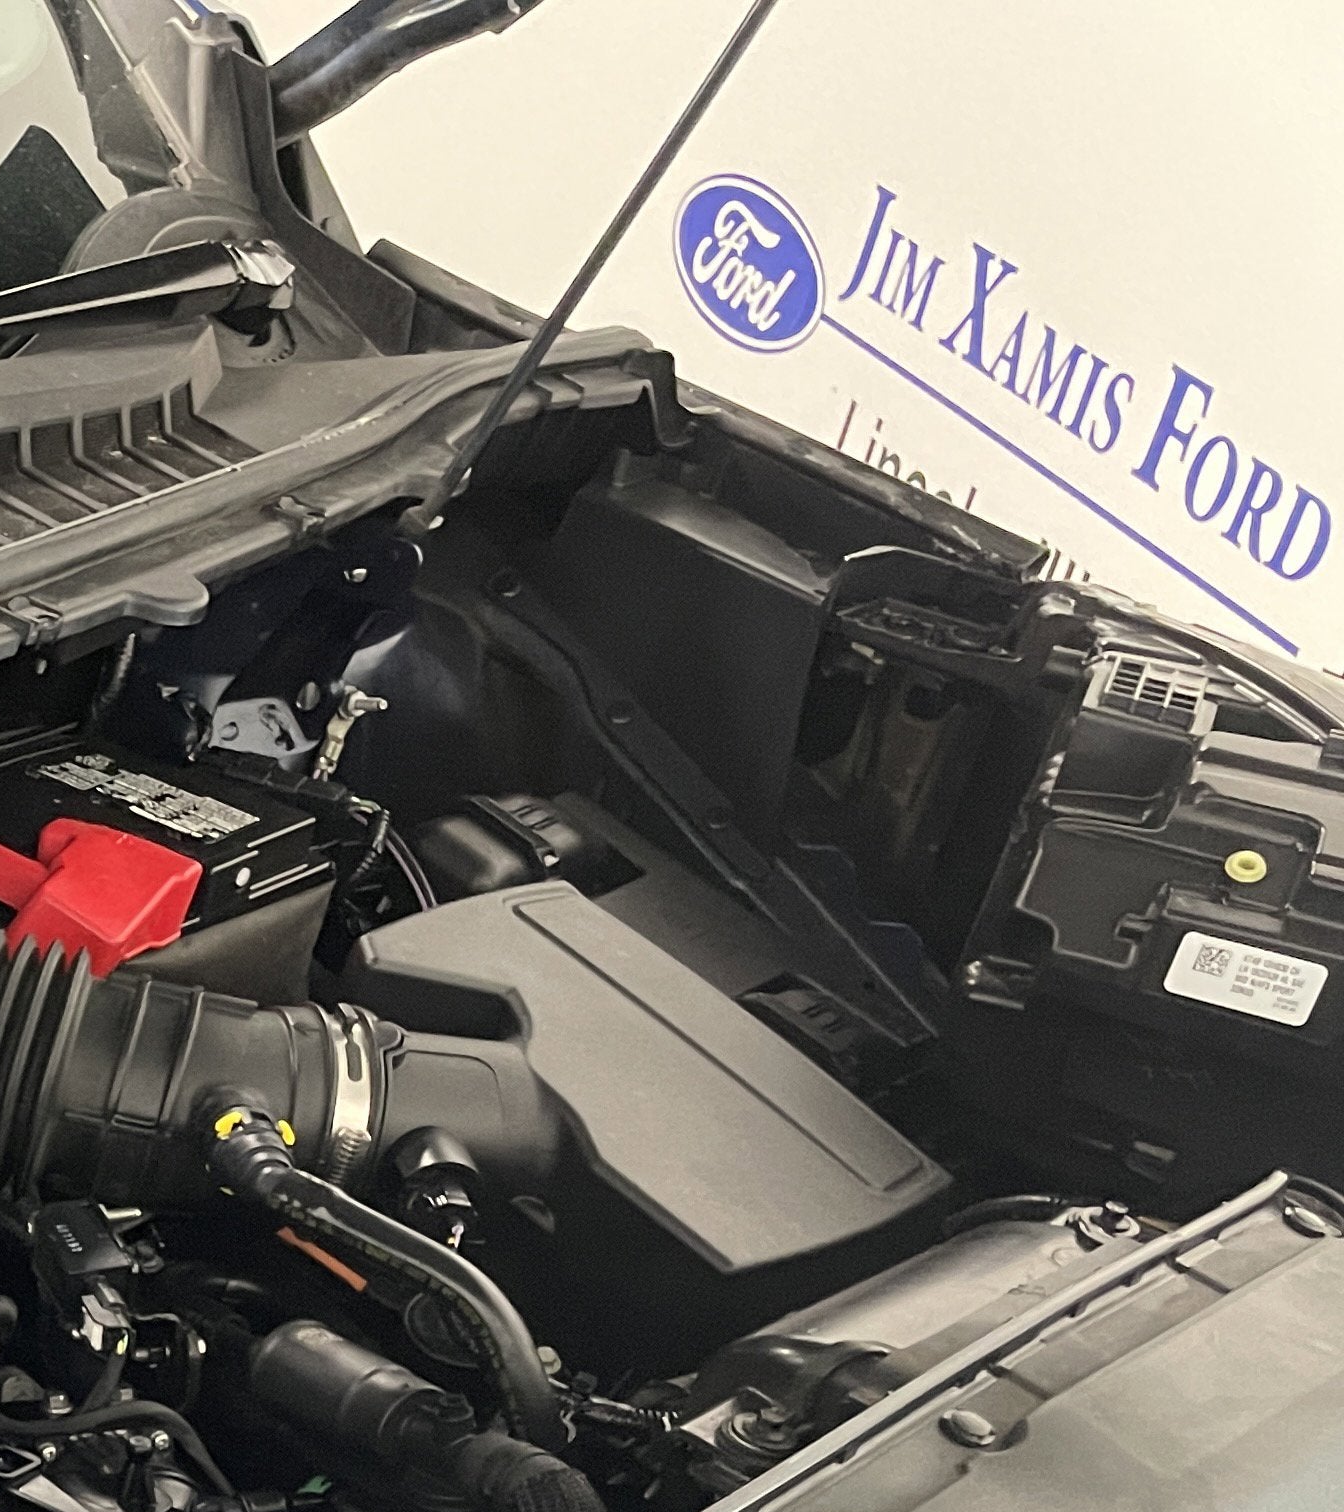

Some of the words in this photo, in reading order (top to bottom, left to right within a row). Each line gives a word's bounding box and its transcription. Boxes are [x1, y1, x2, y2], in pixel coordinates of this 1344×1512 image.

[694, 200, 798, 330] Ford
[839, 185, 945, 332] JIM
[939, 243, 1134, 453] XAMIS
[1131, 363, 1331, 581] FORD
